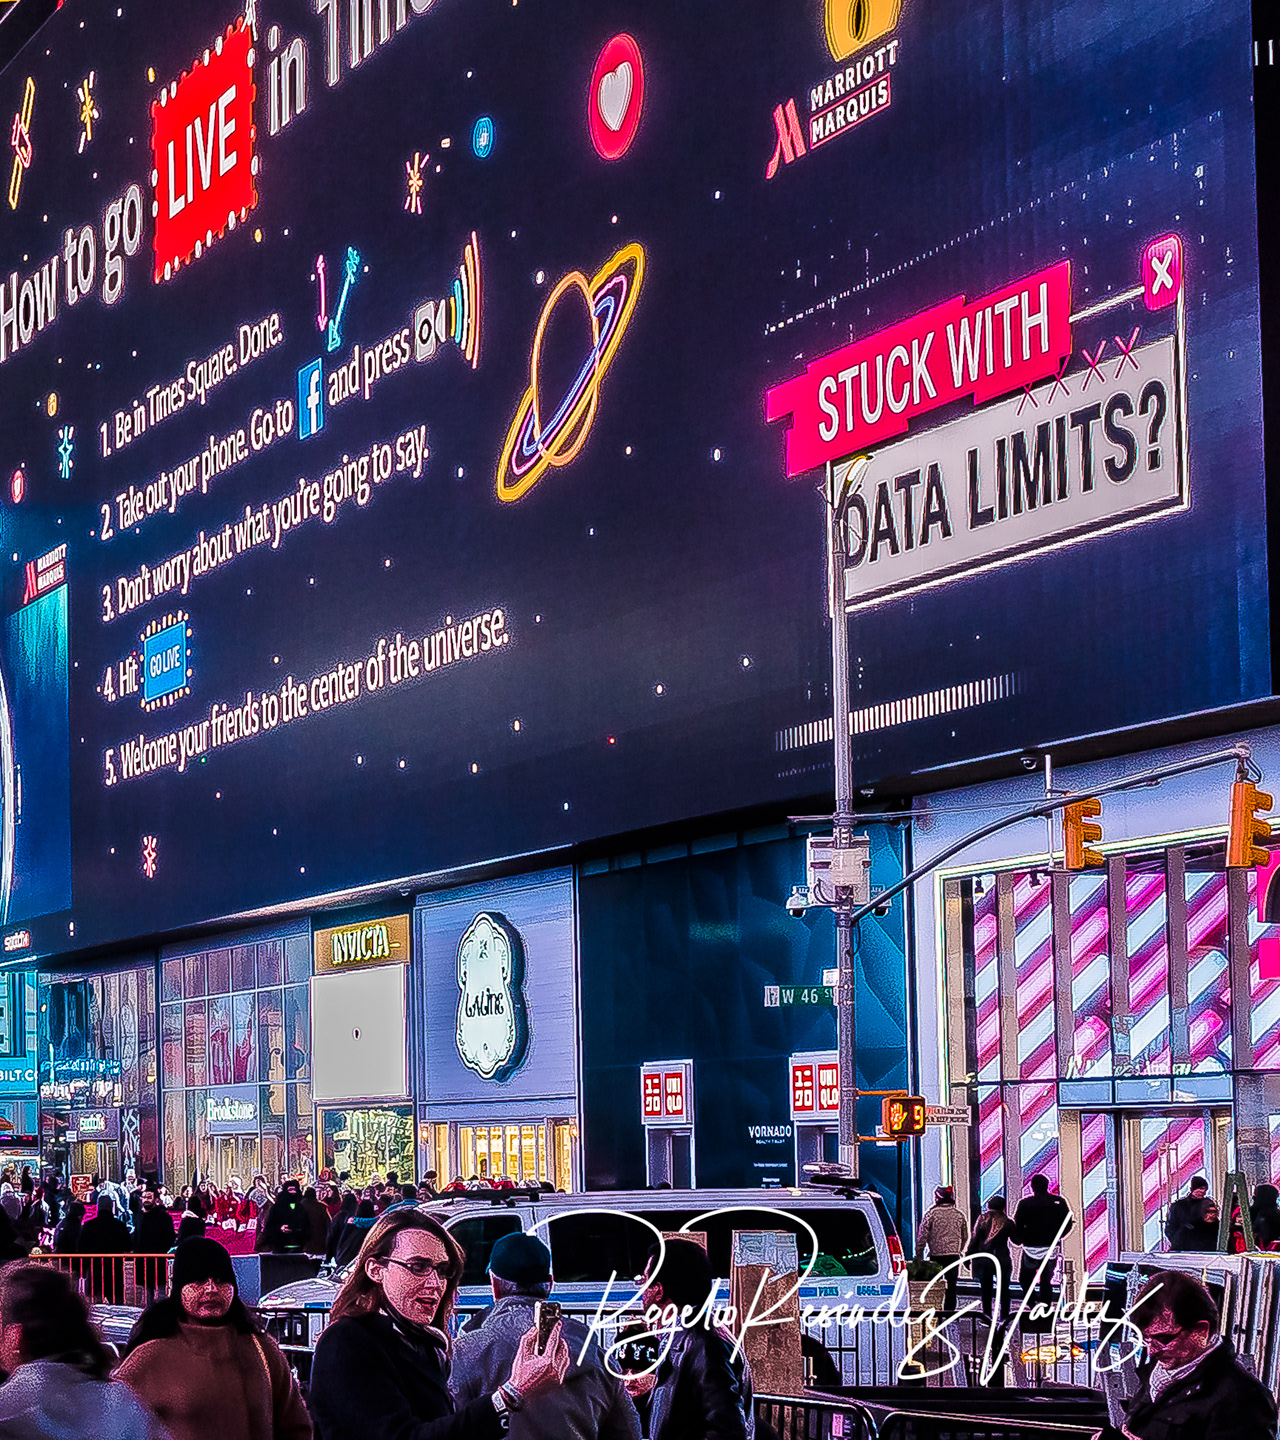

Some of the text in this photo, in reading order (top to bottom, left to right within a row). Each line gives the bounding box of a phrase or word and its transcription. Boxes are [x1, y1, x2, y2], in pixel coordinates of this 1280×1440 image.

[810, 39, 899, 112] MARRIOTT
[811, 79, 889, 144] MARQUIS
[64, 220, 96, 306] to
[102, 182, 144, 304] go
[165, 83, 238, 220] LIVE
[268, 24, 307, 137] in
[114, 414, 134, 449] Be
[134, 403, 147, 439] in
[147, 377, 186, 430] Times
[186, 351, 238, 409] Square.
[239, 313, 284, 370] Done.
[818, 282, 1050, 443] STUCK WITH
[115, 482, 145, 532] Take
[145, 468, 169, 514] out
[168, 455, 201, 507] your
[200, 426, 249, 490] phone.
[250, 409, 272, 452] Go
[274, 397, 294, 436] to
[328, 359, 362, 405] and
[363, 329, 411, 401] press
[842, 380, 1168, 569] DATA LIMITS?
[117, 564, 152, 617] Don't
[151, 547, 192, 609] worry
[192, 524, 234, 582] about
[234, 504, 271, 559] what
[271, 478, 321, 550] you're
[323, 455, 371, 528] going
[371, 440, 394, 484] to
[395, 424, 430, 479] say.
[37, 544, 68, 574] MARRIOTT
[118, 655, 139, 697] Hit
[150, 650, 164, 678] GO
[164, 642, 181, 674] LIVE
[120, 725, 177, 782] Welcome
[178, 722, 211, 777] your
[210, 688, 260, 750] friends
[261, 687, 279, 732] to
[279, 673, 309, 721] the
[309, 660, 363, 719] center
[364, 645, 386, 692] of
[386, 633, 420, 685] the
[421, 607, 510, 677] universe.
[331, 924, 389, 965] INVICTA
[782, 988, 819, 1004] W 46
[665, 1078, 682, 1094] UNI
[665, 1096, 683, 1114] QLO
[818, 1068, 837, 1086] UNI
[206, 1097, 256, 1122] Brookstone
[748, 1125, 792, 1139] VORNADO
